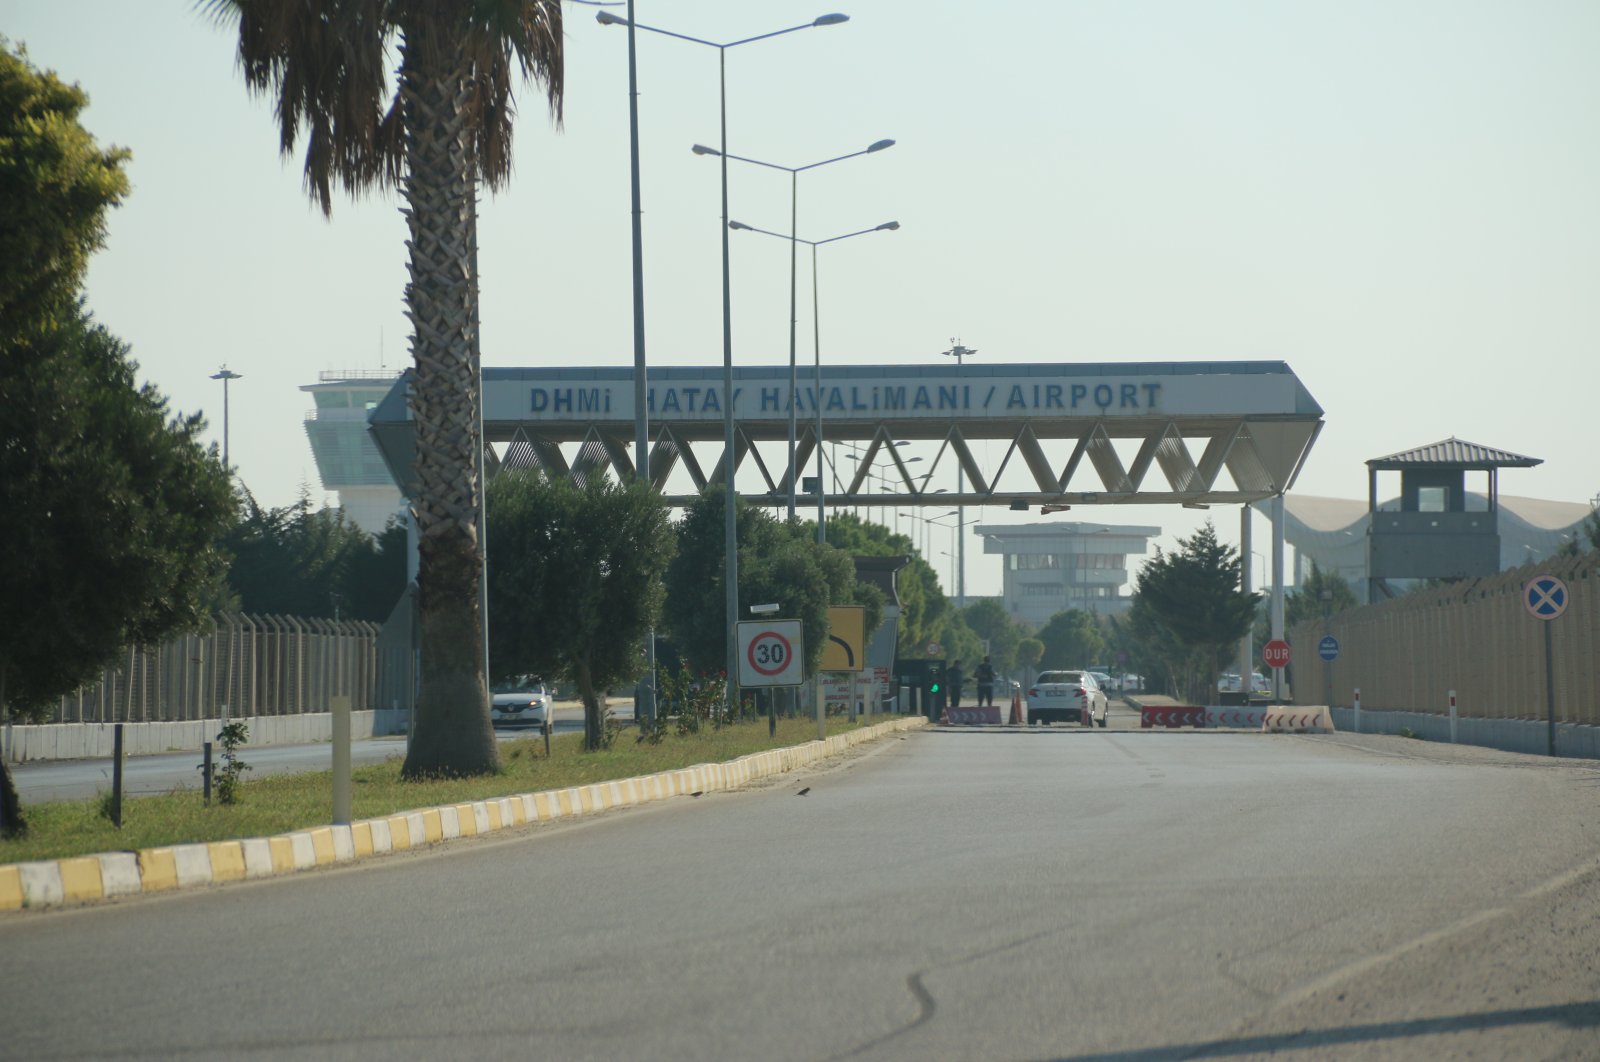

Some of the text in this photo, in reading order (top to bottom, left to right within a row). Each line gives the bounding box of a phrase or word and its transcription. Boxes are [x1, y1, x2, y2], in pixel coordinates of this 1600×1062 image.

[983, 385, 997, 409] /
[1006, 383, 1162, 409] AIRPORT
[757, 643, 784, 664] 30
[1265, 648, 1289, 660] DUR
